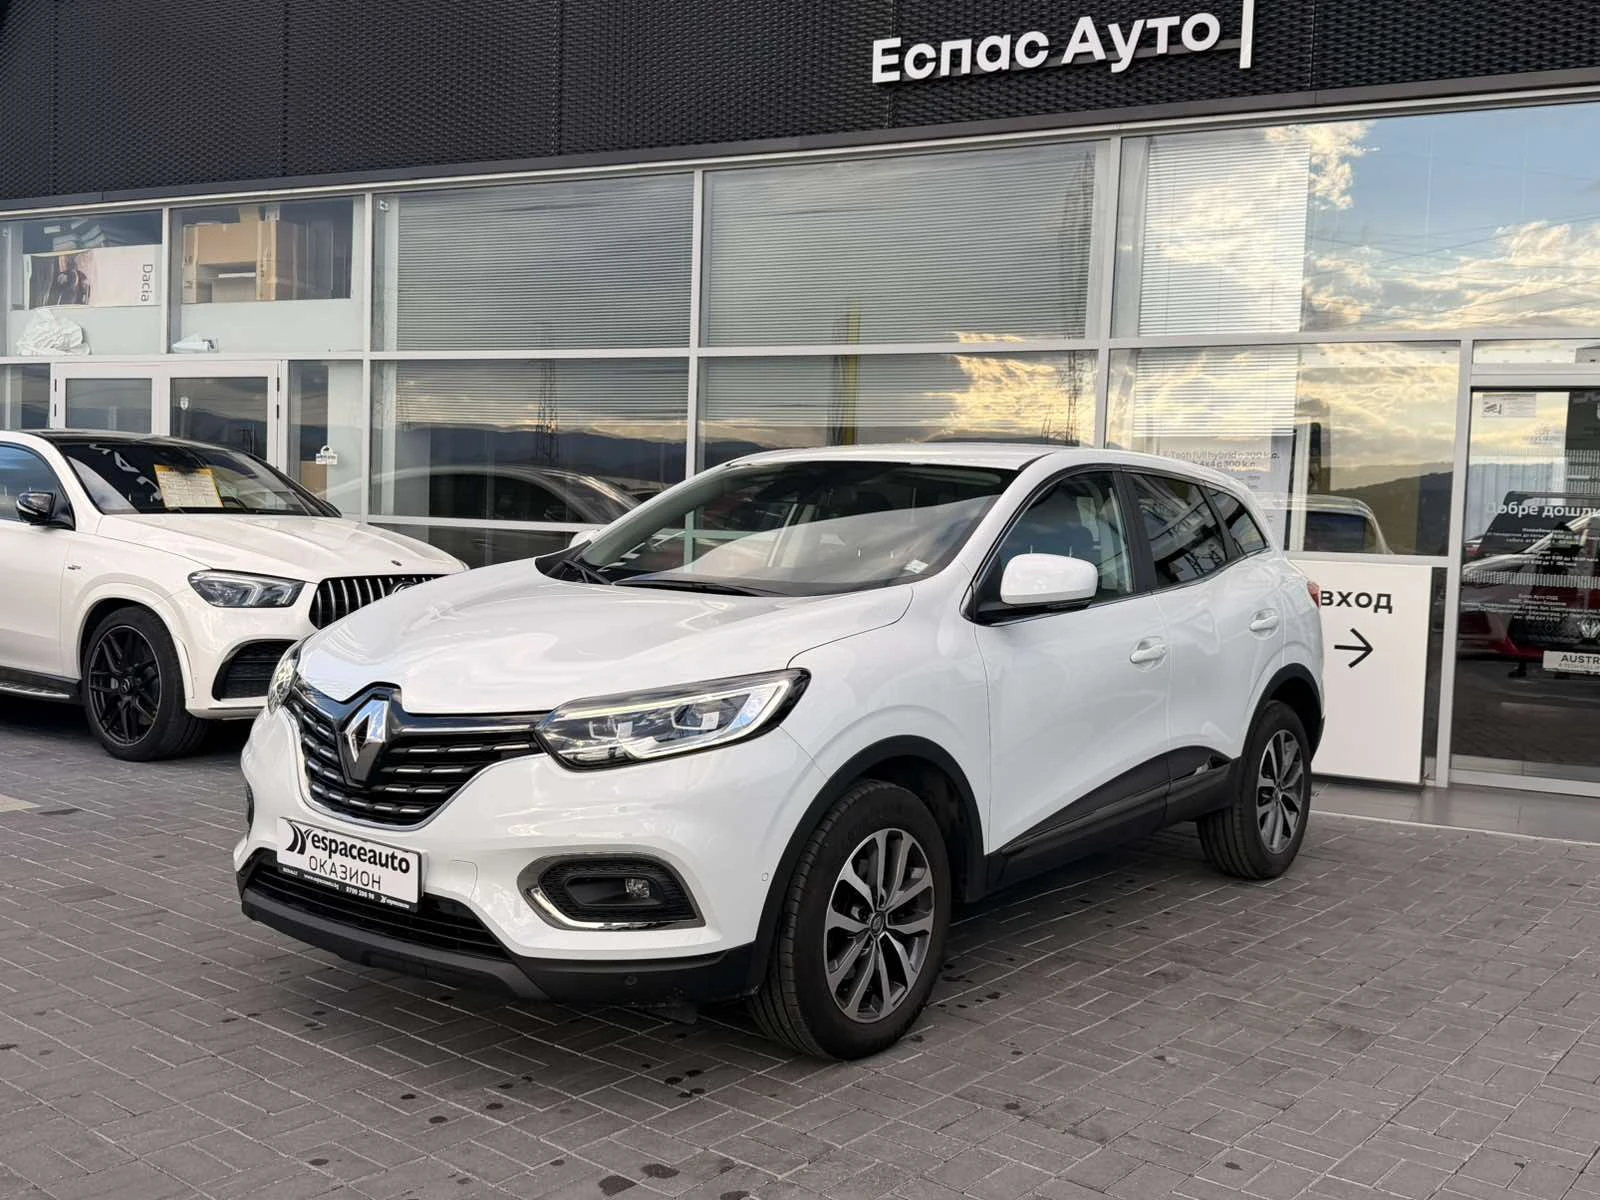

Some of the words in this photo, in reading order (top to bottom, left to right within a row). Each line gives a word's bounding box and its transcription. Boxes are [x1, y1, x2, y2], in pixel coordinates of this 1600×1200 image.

[872, 31, 1050, 84] Еспас
[1061, 12, 1221, 74] Ауто
[141, 264, 153, 302] Dacia
[1487, 501, 1539, 518] Добре
[311, 833, 410, 874] espaceauto
[309, 856, 381, 890] ОКАЗИОН
